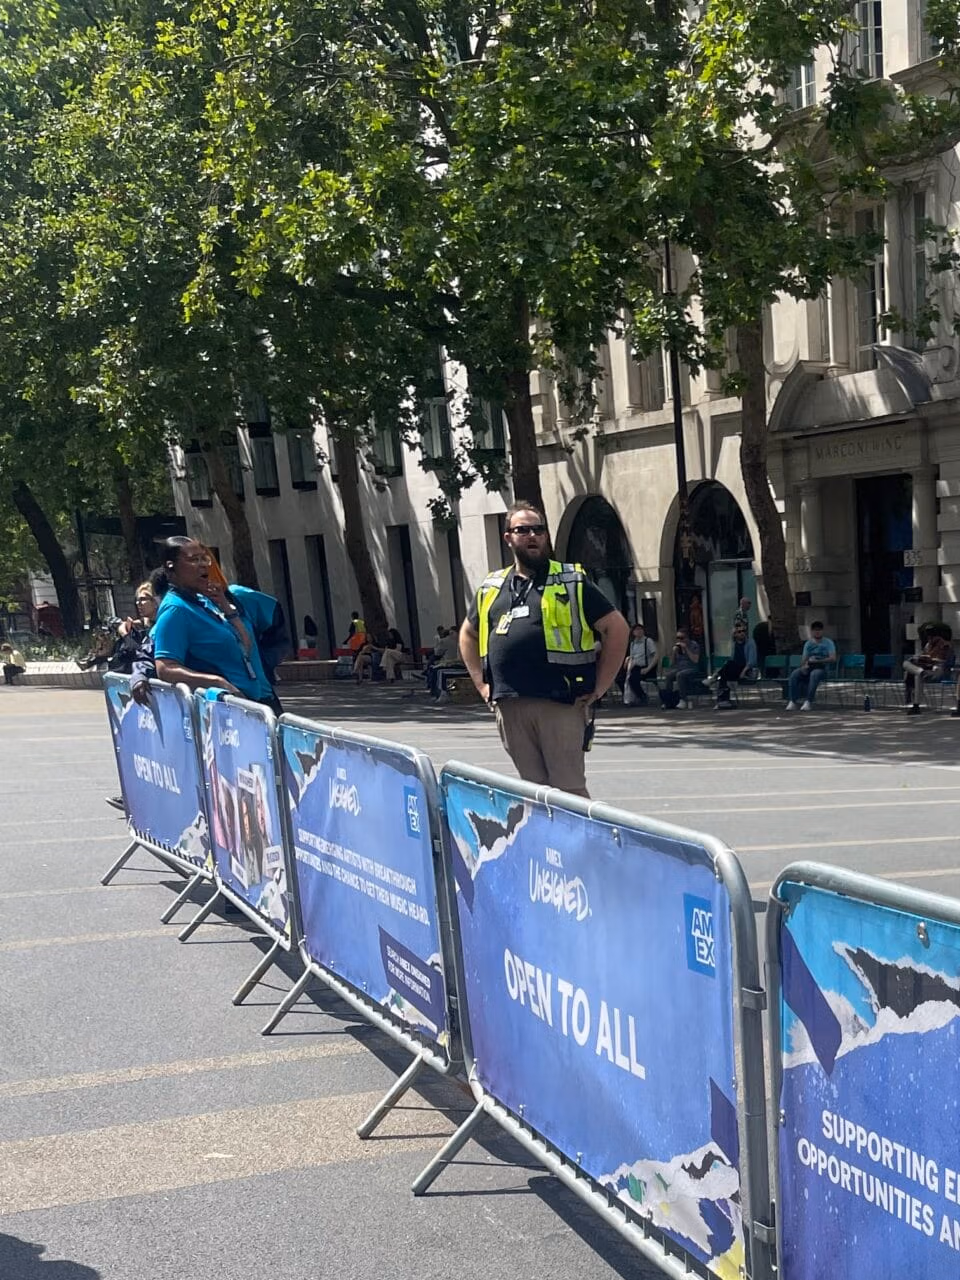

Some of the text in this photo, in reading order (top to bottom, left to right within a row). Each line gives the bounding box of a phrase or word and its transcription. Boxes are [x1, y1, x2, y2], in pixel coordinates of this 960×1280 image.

[163, 764, 181, 795] ALL
[529, 858, 593, 922] UNSIGNED.
[503, 948, 646, 1081] OPEN TO ALL
[797, 1138, 935, 1238] OPPORTUNITIES
[821, 1109, 940, 1194] SUPPORTING
